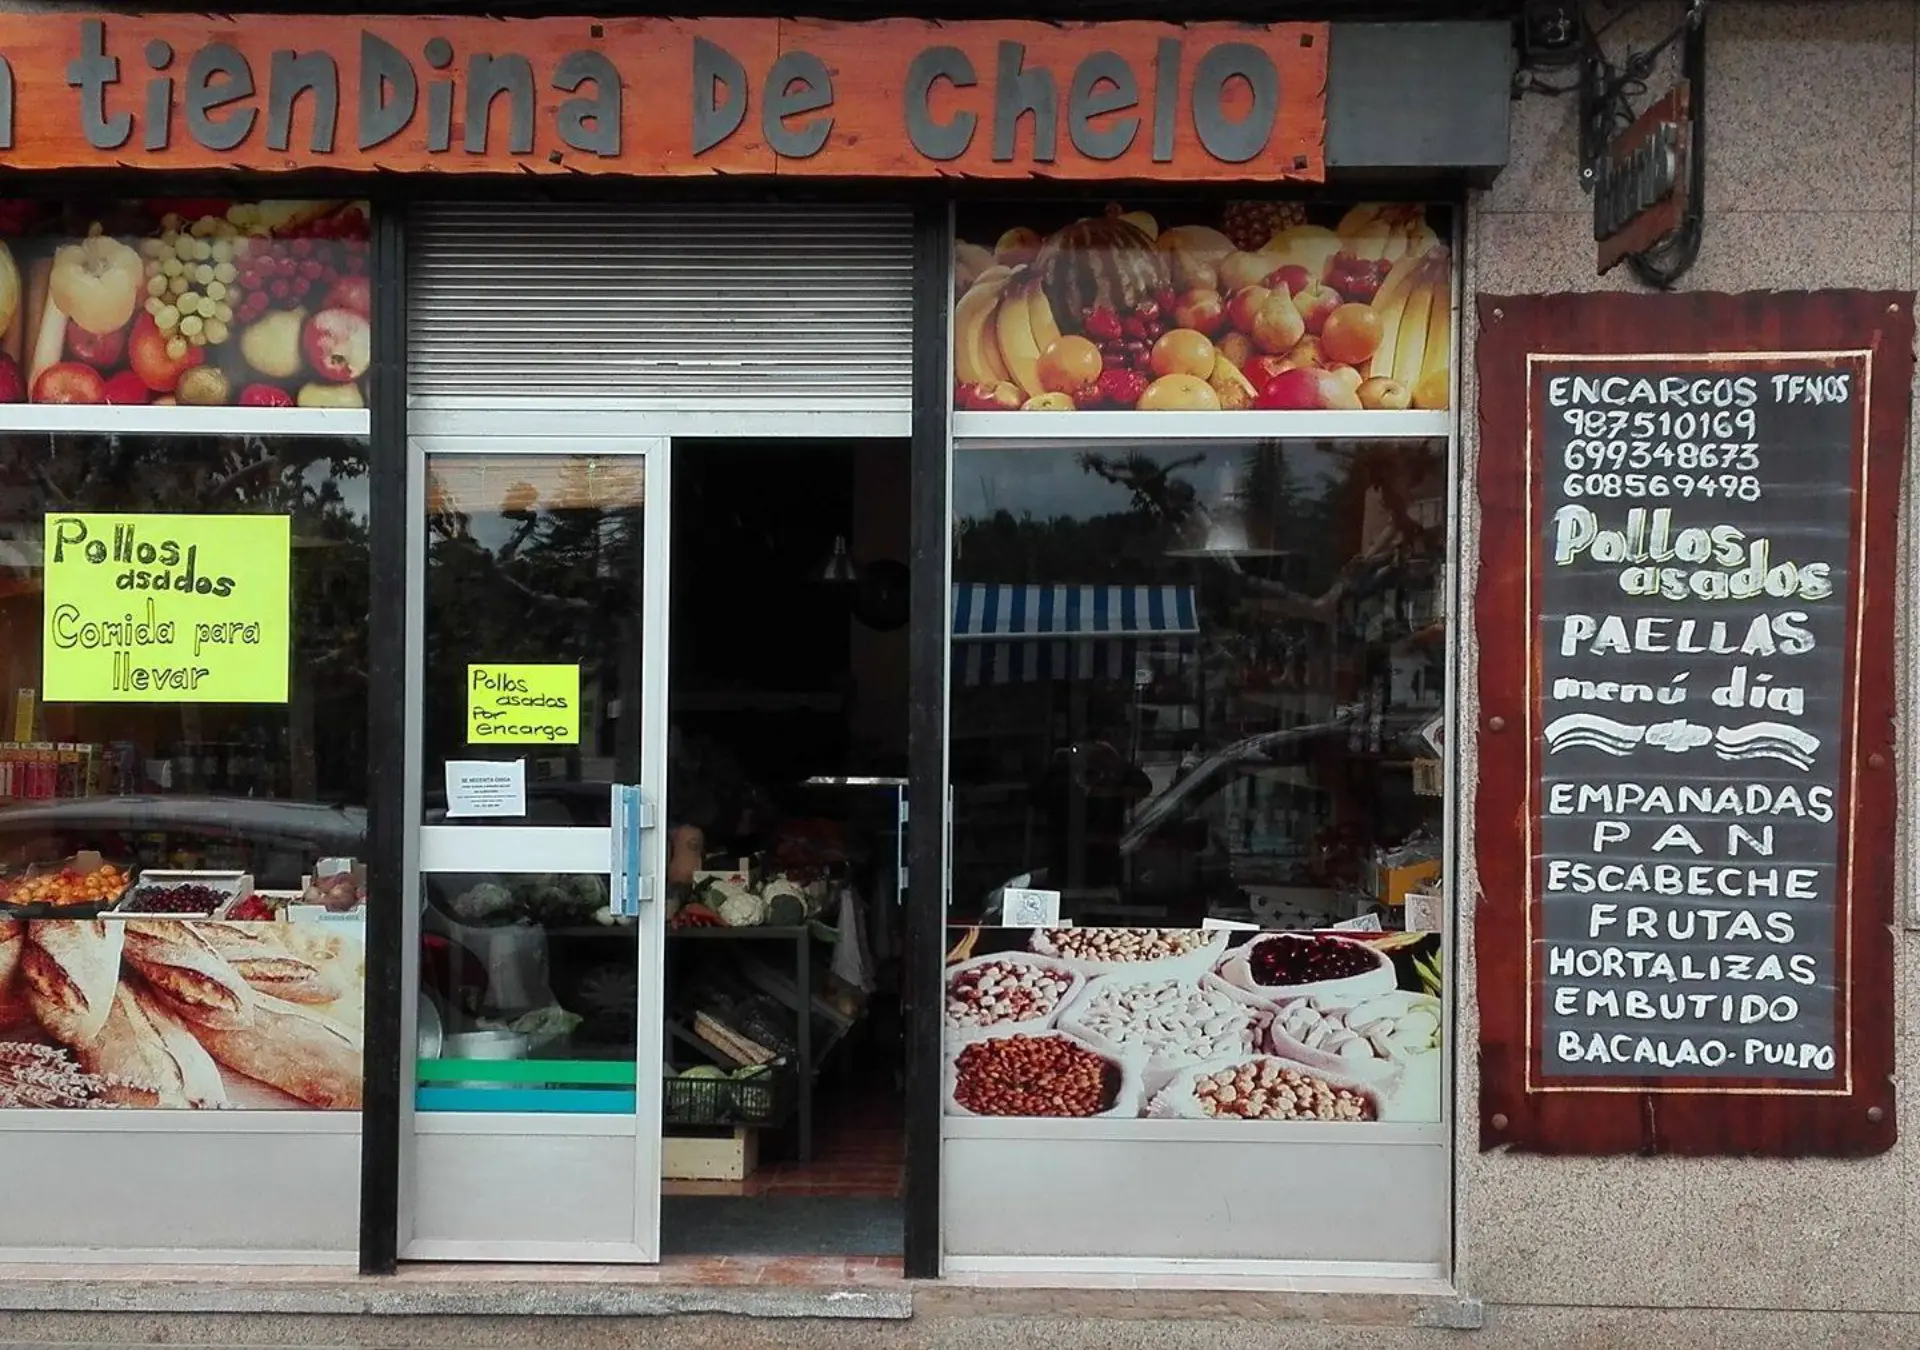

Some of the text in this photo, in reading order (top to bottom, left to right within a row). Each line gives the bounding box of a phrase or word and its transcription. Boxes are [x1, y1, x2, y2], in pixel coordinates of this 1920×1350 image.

[1549, 374, 1850, 406] ENCARGOS TFNOS
[1562, 408, 1757, 440] 987510169
[1563, 439, 1760, 471] 699348673
[1563, 473, 1762, 502] 608569498
[52, 517, 182, 567] Pollos
[1551, 503, 1746, 567] Pollos
[115, 544, 237, 598] asados
[1619, 537, 1834, 600] asados
[51, 597, 261, 657] Comida para
[1560, 610, 1817, 658] PAELLAS
[111, 650, 211, 692] llevar
[472, 669, 529, 693] Pollos
[1552, 665, 1806, 716] menú día
[495, 693, 569, 709] asados
[475, 722, 569, 741] encargo
[1549, 783, 1835, 824] EMPANADAS
[1592, 820, 1775, 856] PAN
[1547, 860, 1819, 900] ESCABECHE
[1588, 902, 1796, 944] FRUTAS
[1549, 946, 1818, 985] HORTALIZAS
[1553, 986, 1800, 1025] EMBUTIDO
[1744, 1038, 1837, 1072] PULPO
